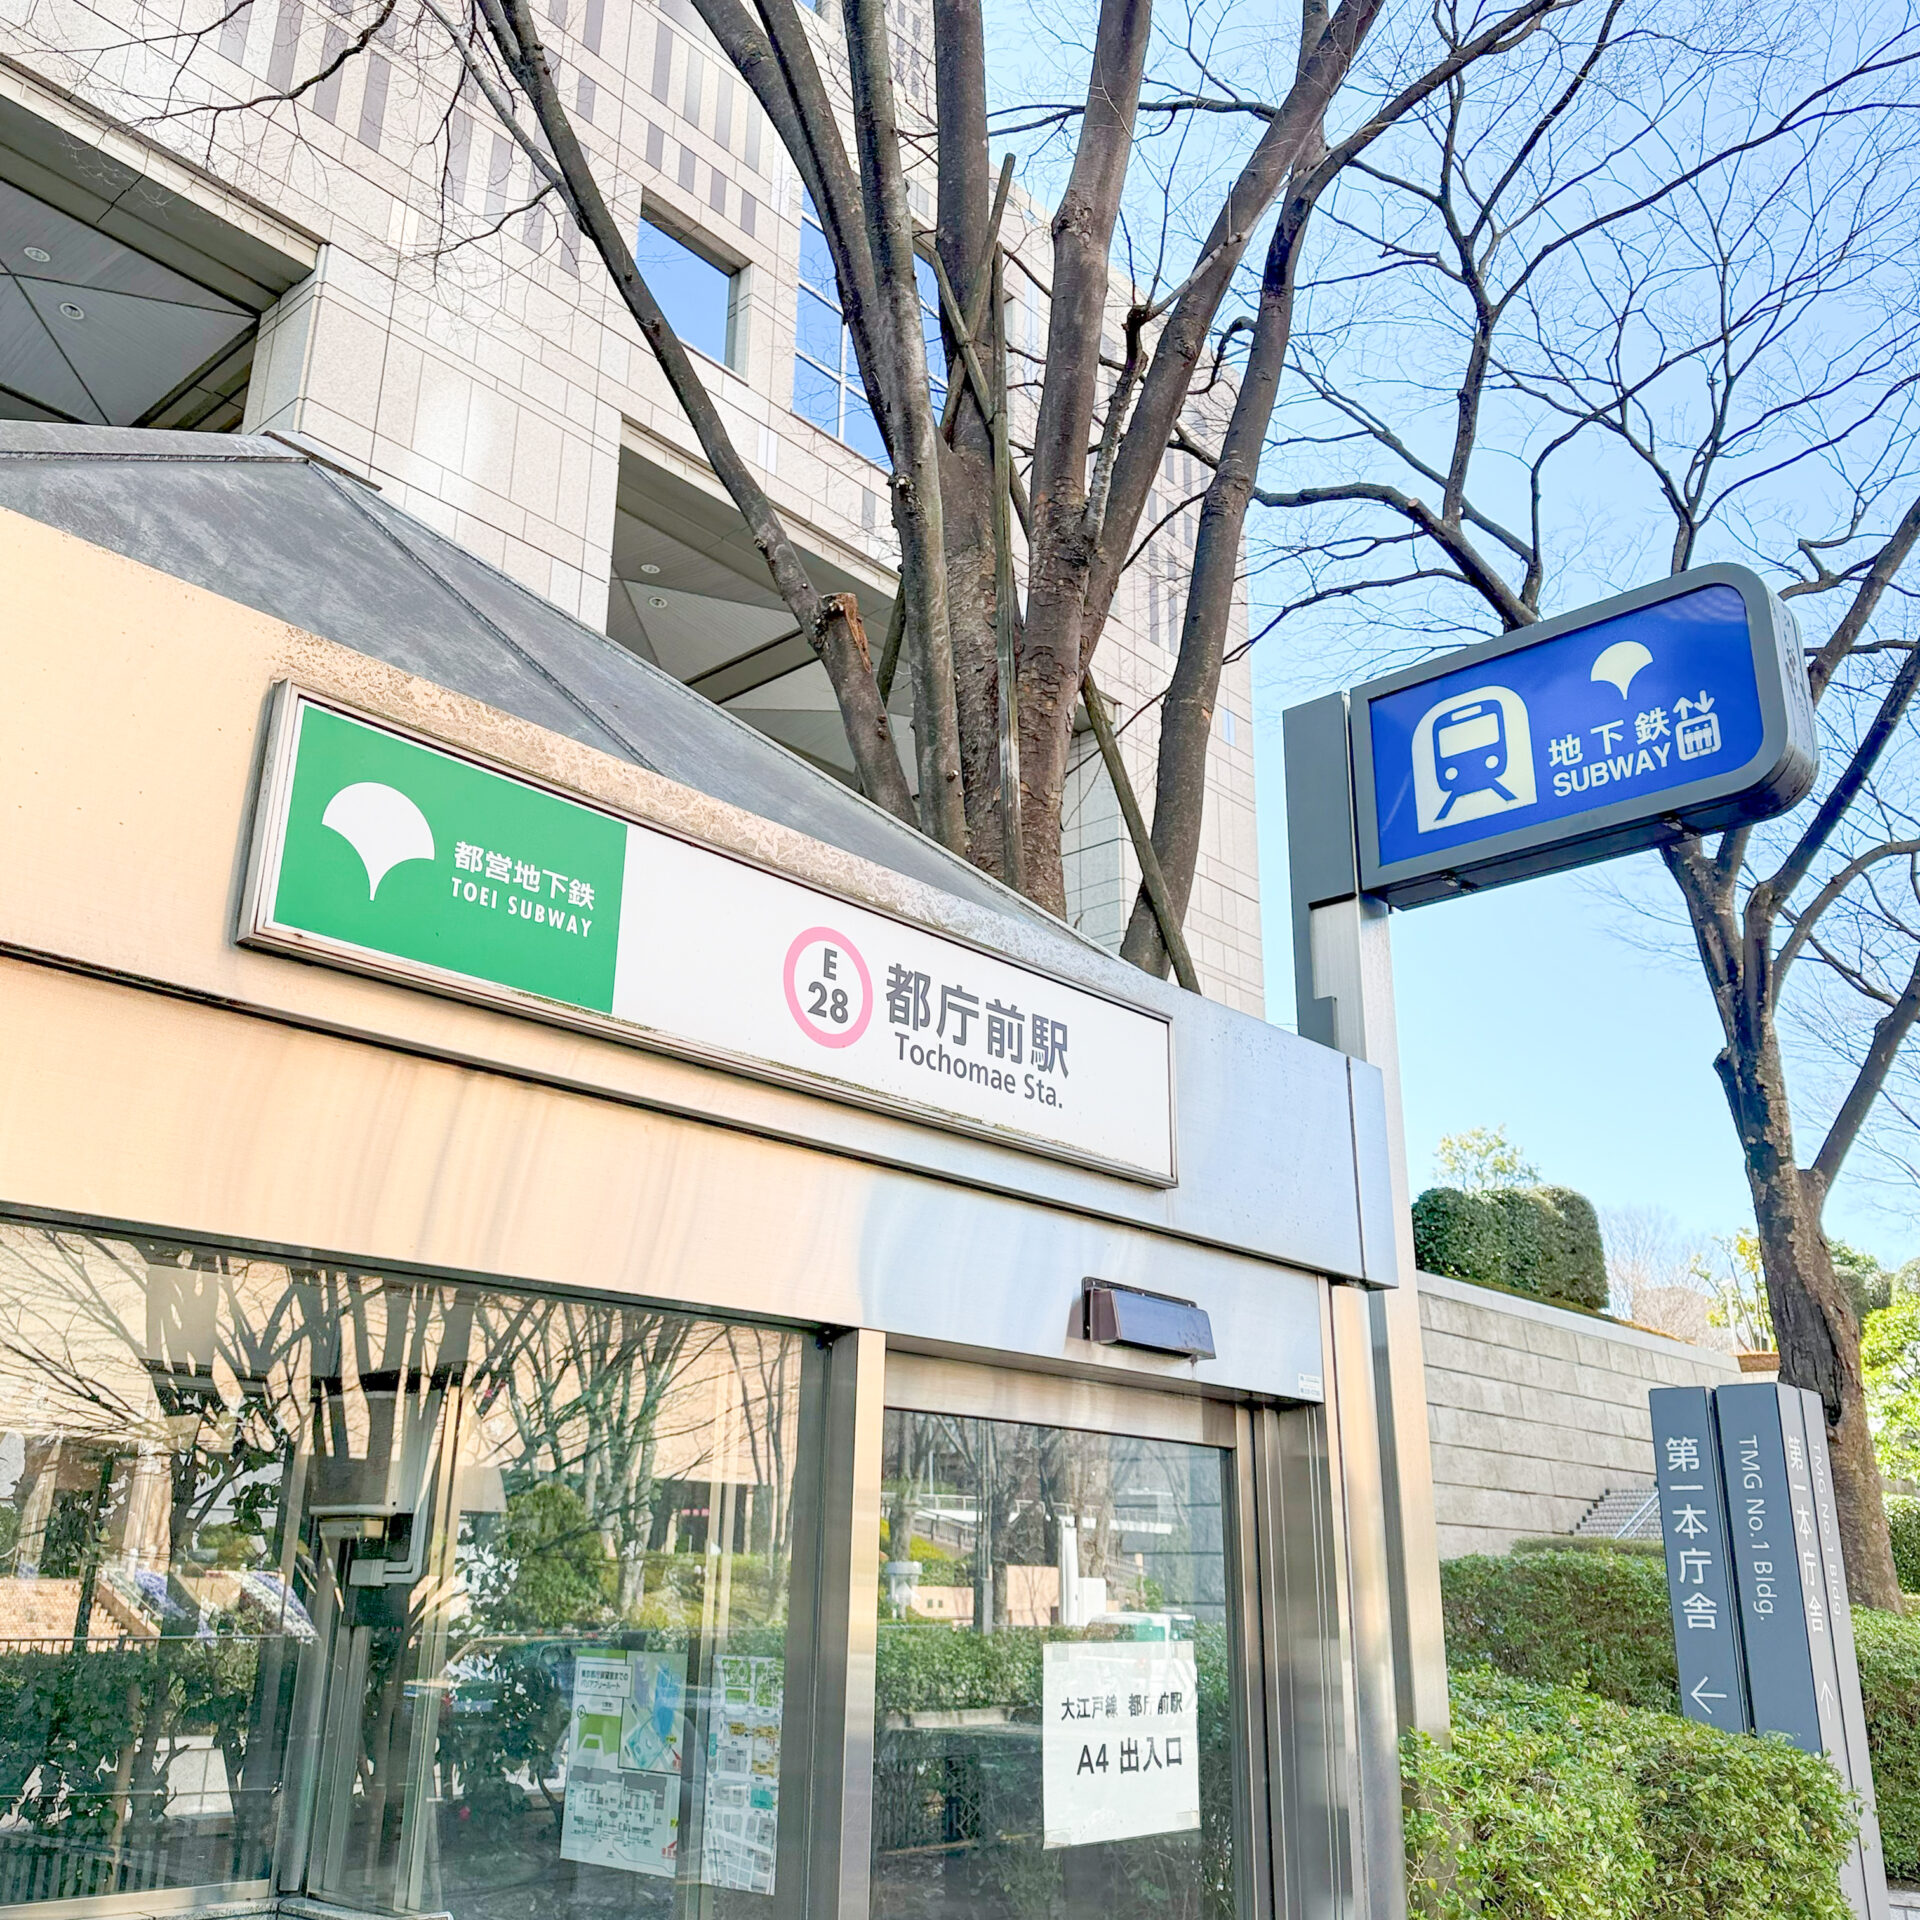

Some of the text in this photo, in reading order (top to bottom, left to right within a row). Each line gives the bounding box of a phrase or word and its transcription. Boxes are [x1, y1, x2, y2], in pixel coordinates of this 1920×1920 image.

[1549, 707, 1671, 767] 地下鉄
[1553, 742, 1671, 797] SUBWAY
[454, 841, 595, 911] 都営地下鉄
[452, 877, 592, 937] TOEI SUBWAY
[823, 948, 838, 981] E
[808, 981, 848, 1024] 28
[886, 963, 1069, 1078] 都庁前駅
[894, 1031, 1063, 1108] Tochomae Sta.
[1812, 1441, 1827, 1494] TMG
[1665, 1436, 1718, 1630] 第一本庁舎
[1739, 1434, 1777, 1621] TMG No.1 Bldg.
[1788, 1436, 1824, 1632] 第一本庁舎
[1061, 1694, 1118, 1721] 大江戸線
[1077, 1737, 1182, 1775] A4 出入口
